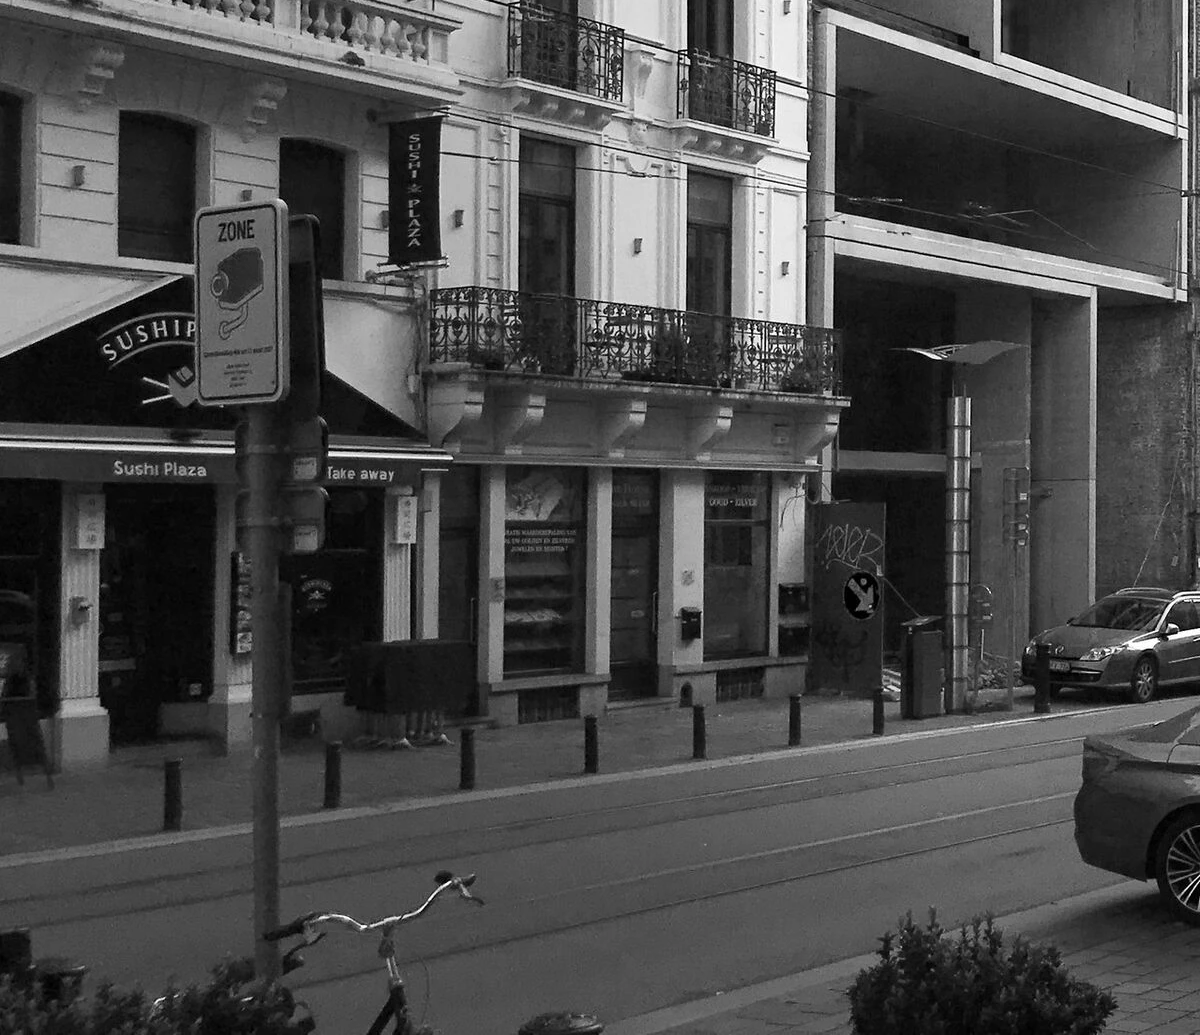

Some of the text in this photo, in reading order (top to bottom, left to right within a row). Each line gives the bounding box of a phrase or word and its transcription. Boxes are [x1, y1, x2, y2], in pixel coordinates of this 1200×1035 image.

[407, 133, 421, 247] SUSHI PLAZA
[218, 219, 256, 242] ZONE
[113, 460, 207, 477] Sushi Plaza
[327, 466, 395, 482] Take away
